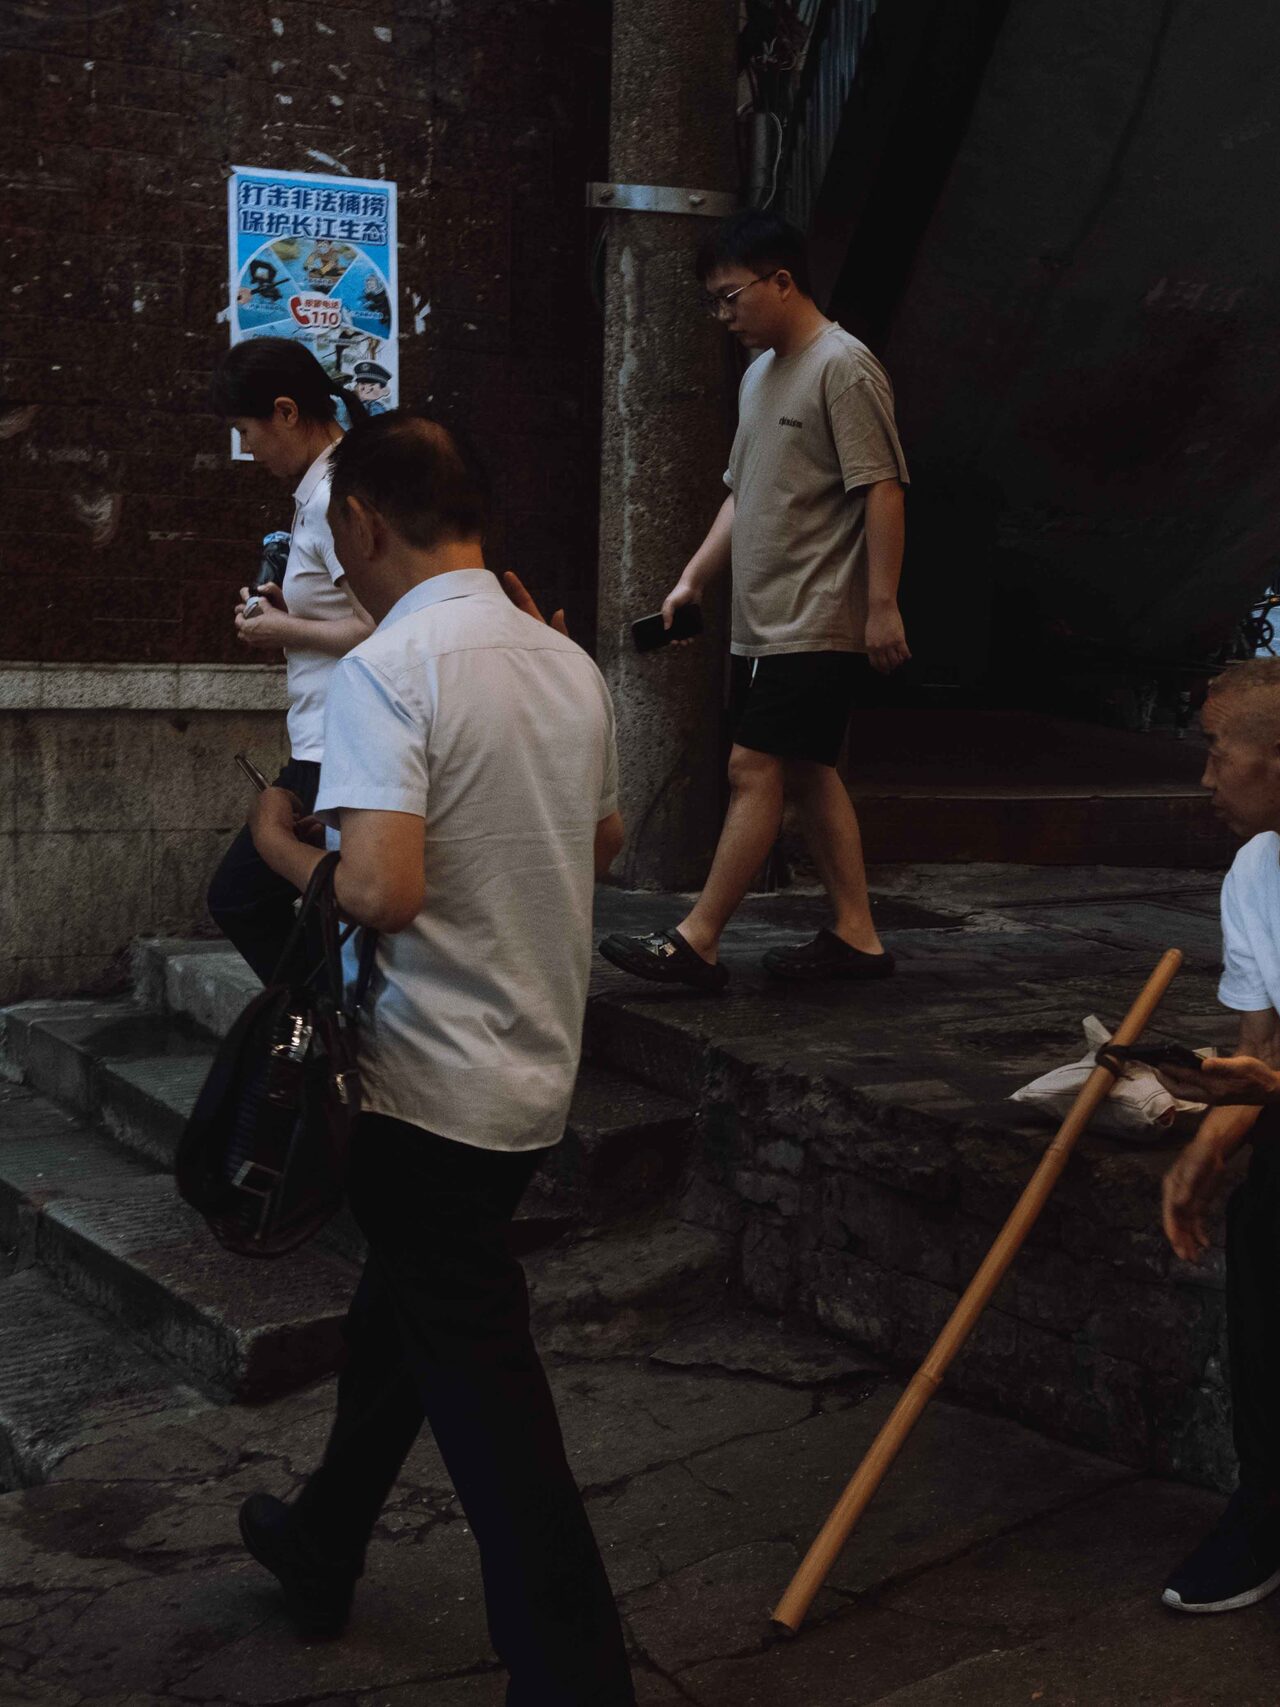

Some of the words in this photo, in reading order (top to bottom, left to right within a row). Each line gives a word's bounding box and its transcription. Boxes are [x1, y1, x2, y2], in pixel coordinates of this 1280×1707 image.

[239, 184, 387, 217] 打击非法捕捞
[239, 209, 387, 243] 保护长江生态
[312, 311, 339, 325] 110
